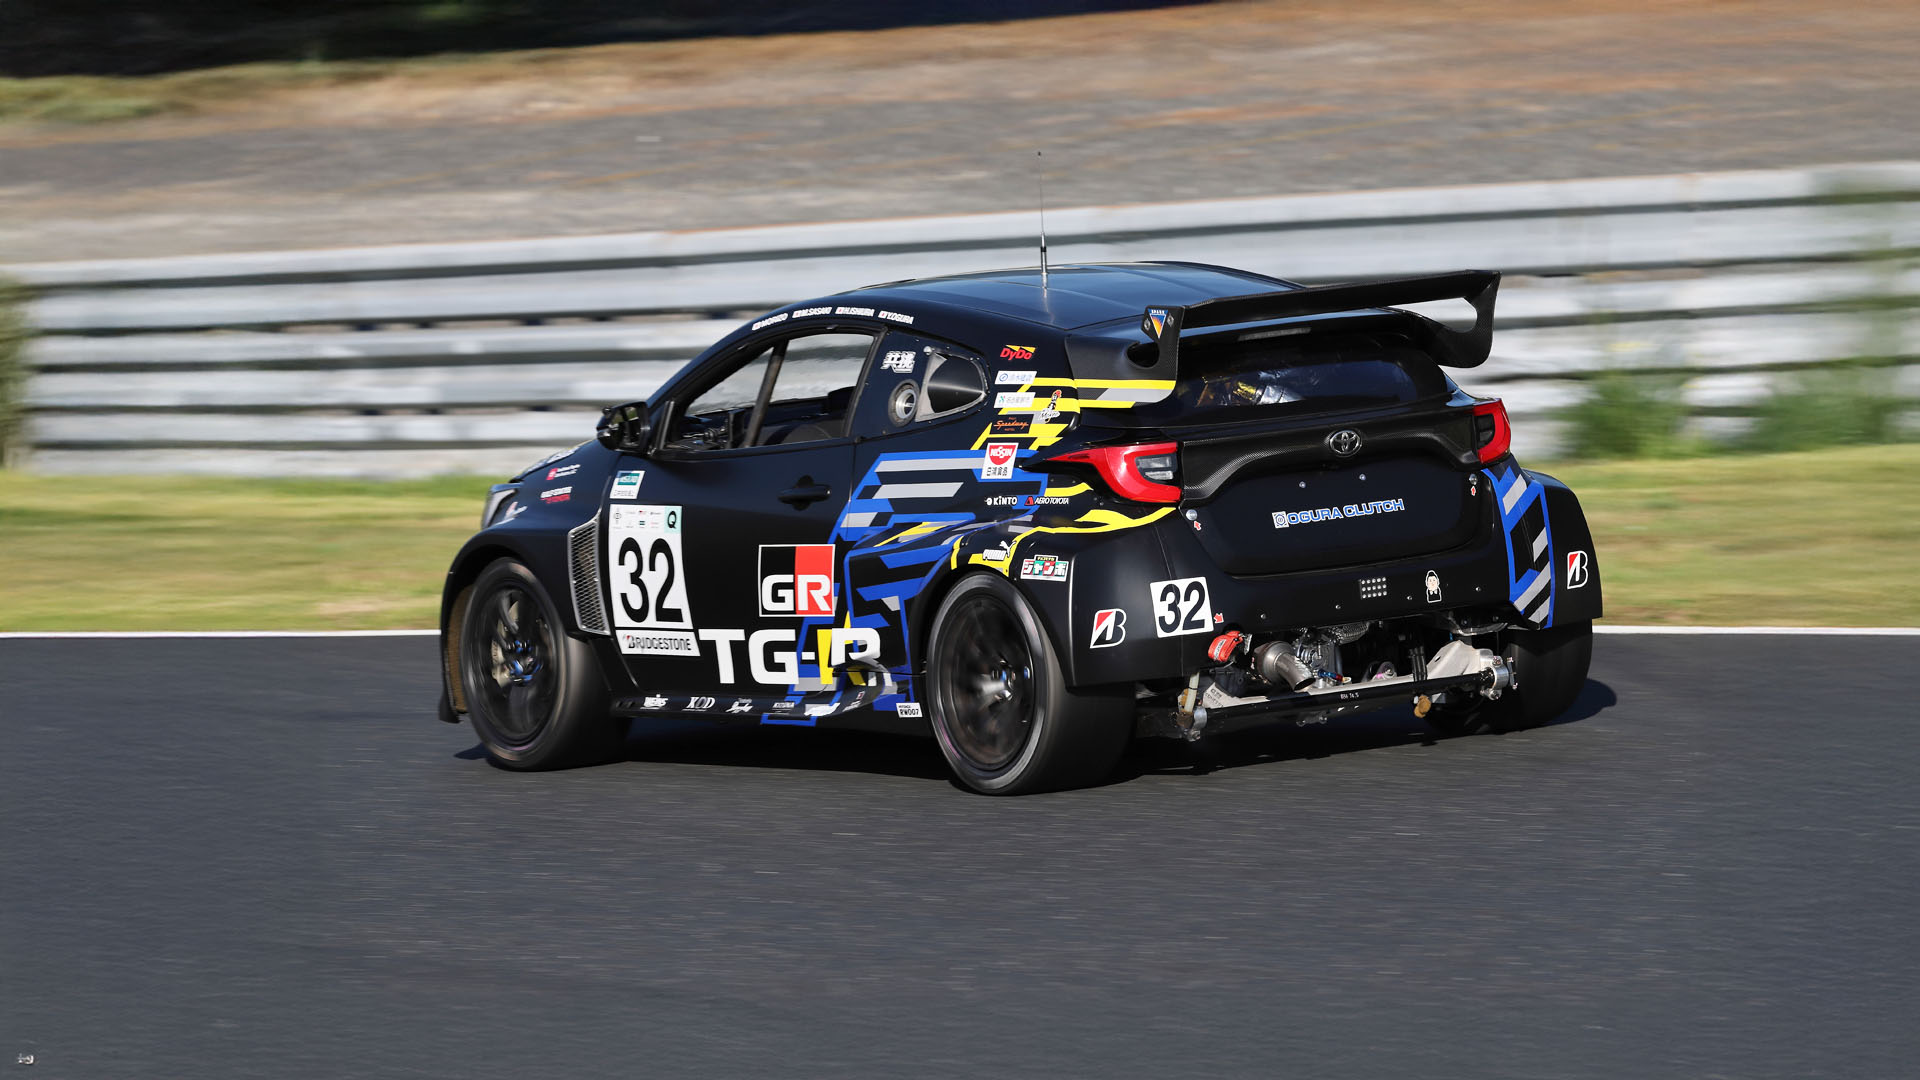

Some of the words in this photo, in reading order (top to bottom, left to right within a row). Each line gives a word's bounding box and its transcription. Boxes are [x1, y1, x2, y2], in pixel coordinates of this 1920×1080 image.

[1000, 348, 1032, 360] DyDo
[990, 446, 1013, 459] NISSIN
[667, 511, 677, 529] Q
[1287, 507, 1343, 524] OGURA
[1343, 498, 1405, 517] CLUTCH
[1022, 562, 1067, 577] ジャンボ
[618, 537, 684, 623] 32
[762, 574, 832, 611] GR
[1158, 581, 1206, 633] 32
[627, 635, 692, 651] BRIDGESTONE
